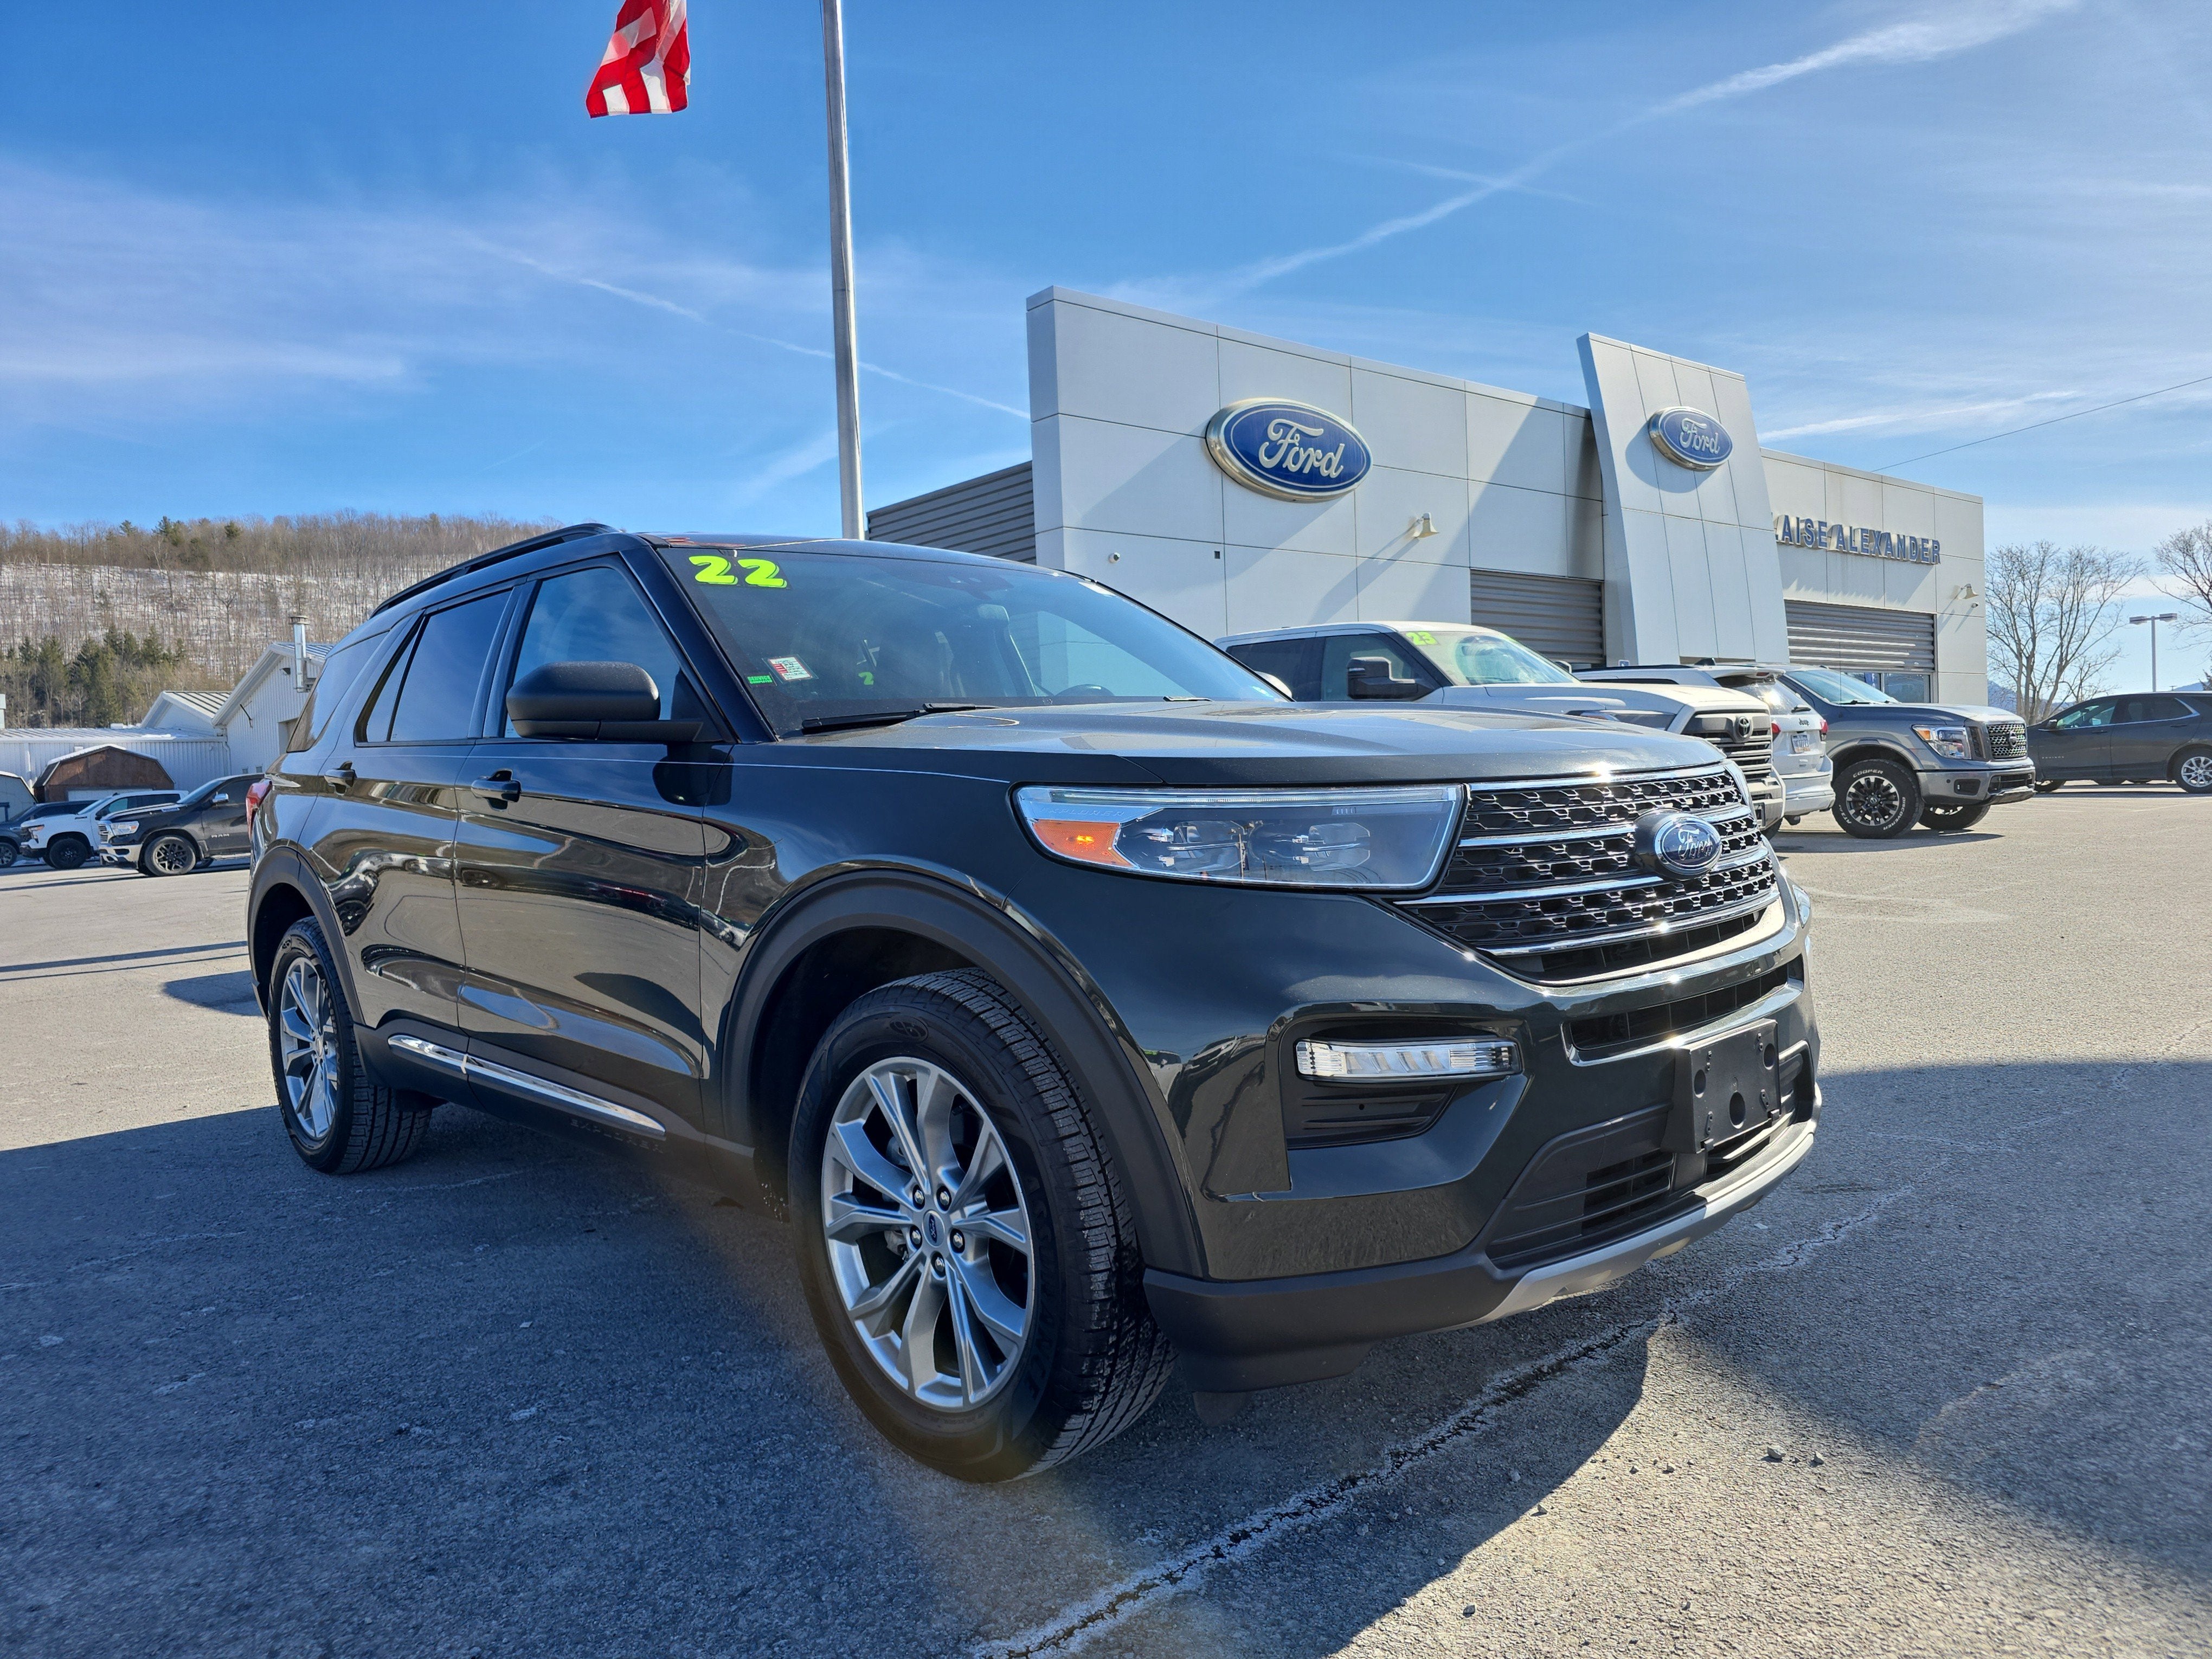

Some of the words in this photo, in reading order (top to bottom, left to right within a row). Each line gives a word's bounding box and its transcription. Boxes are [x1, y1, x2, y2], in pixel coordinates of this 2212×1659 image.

[1258, 419, 1345, 478] Ford
[1680, 417, 1720, 454] Ford
[1776, 515, 1828, 549] AISE
[1830, 524, 1941, 564] ALEXANDER
[689, 555, 787, 588] 22
[1406, 631, 1437, 646] 23
[1853, 769, 1883, 778] COOPER
[1041, 807, 1124, 817] EXPLORER
[1883, 796, 1906, 831] DISCOVERER
[1678, 828, 1713, 861] Ford
